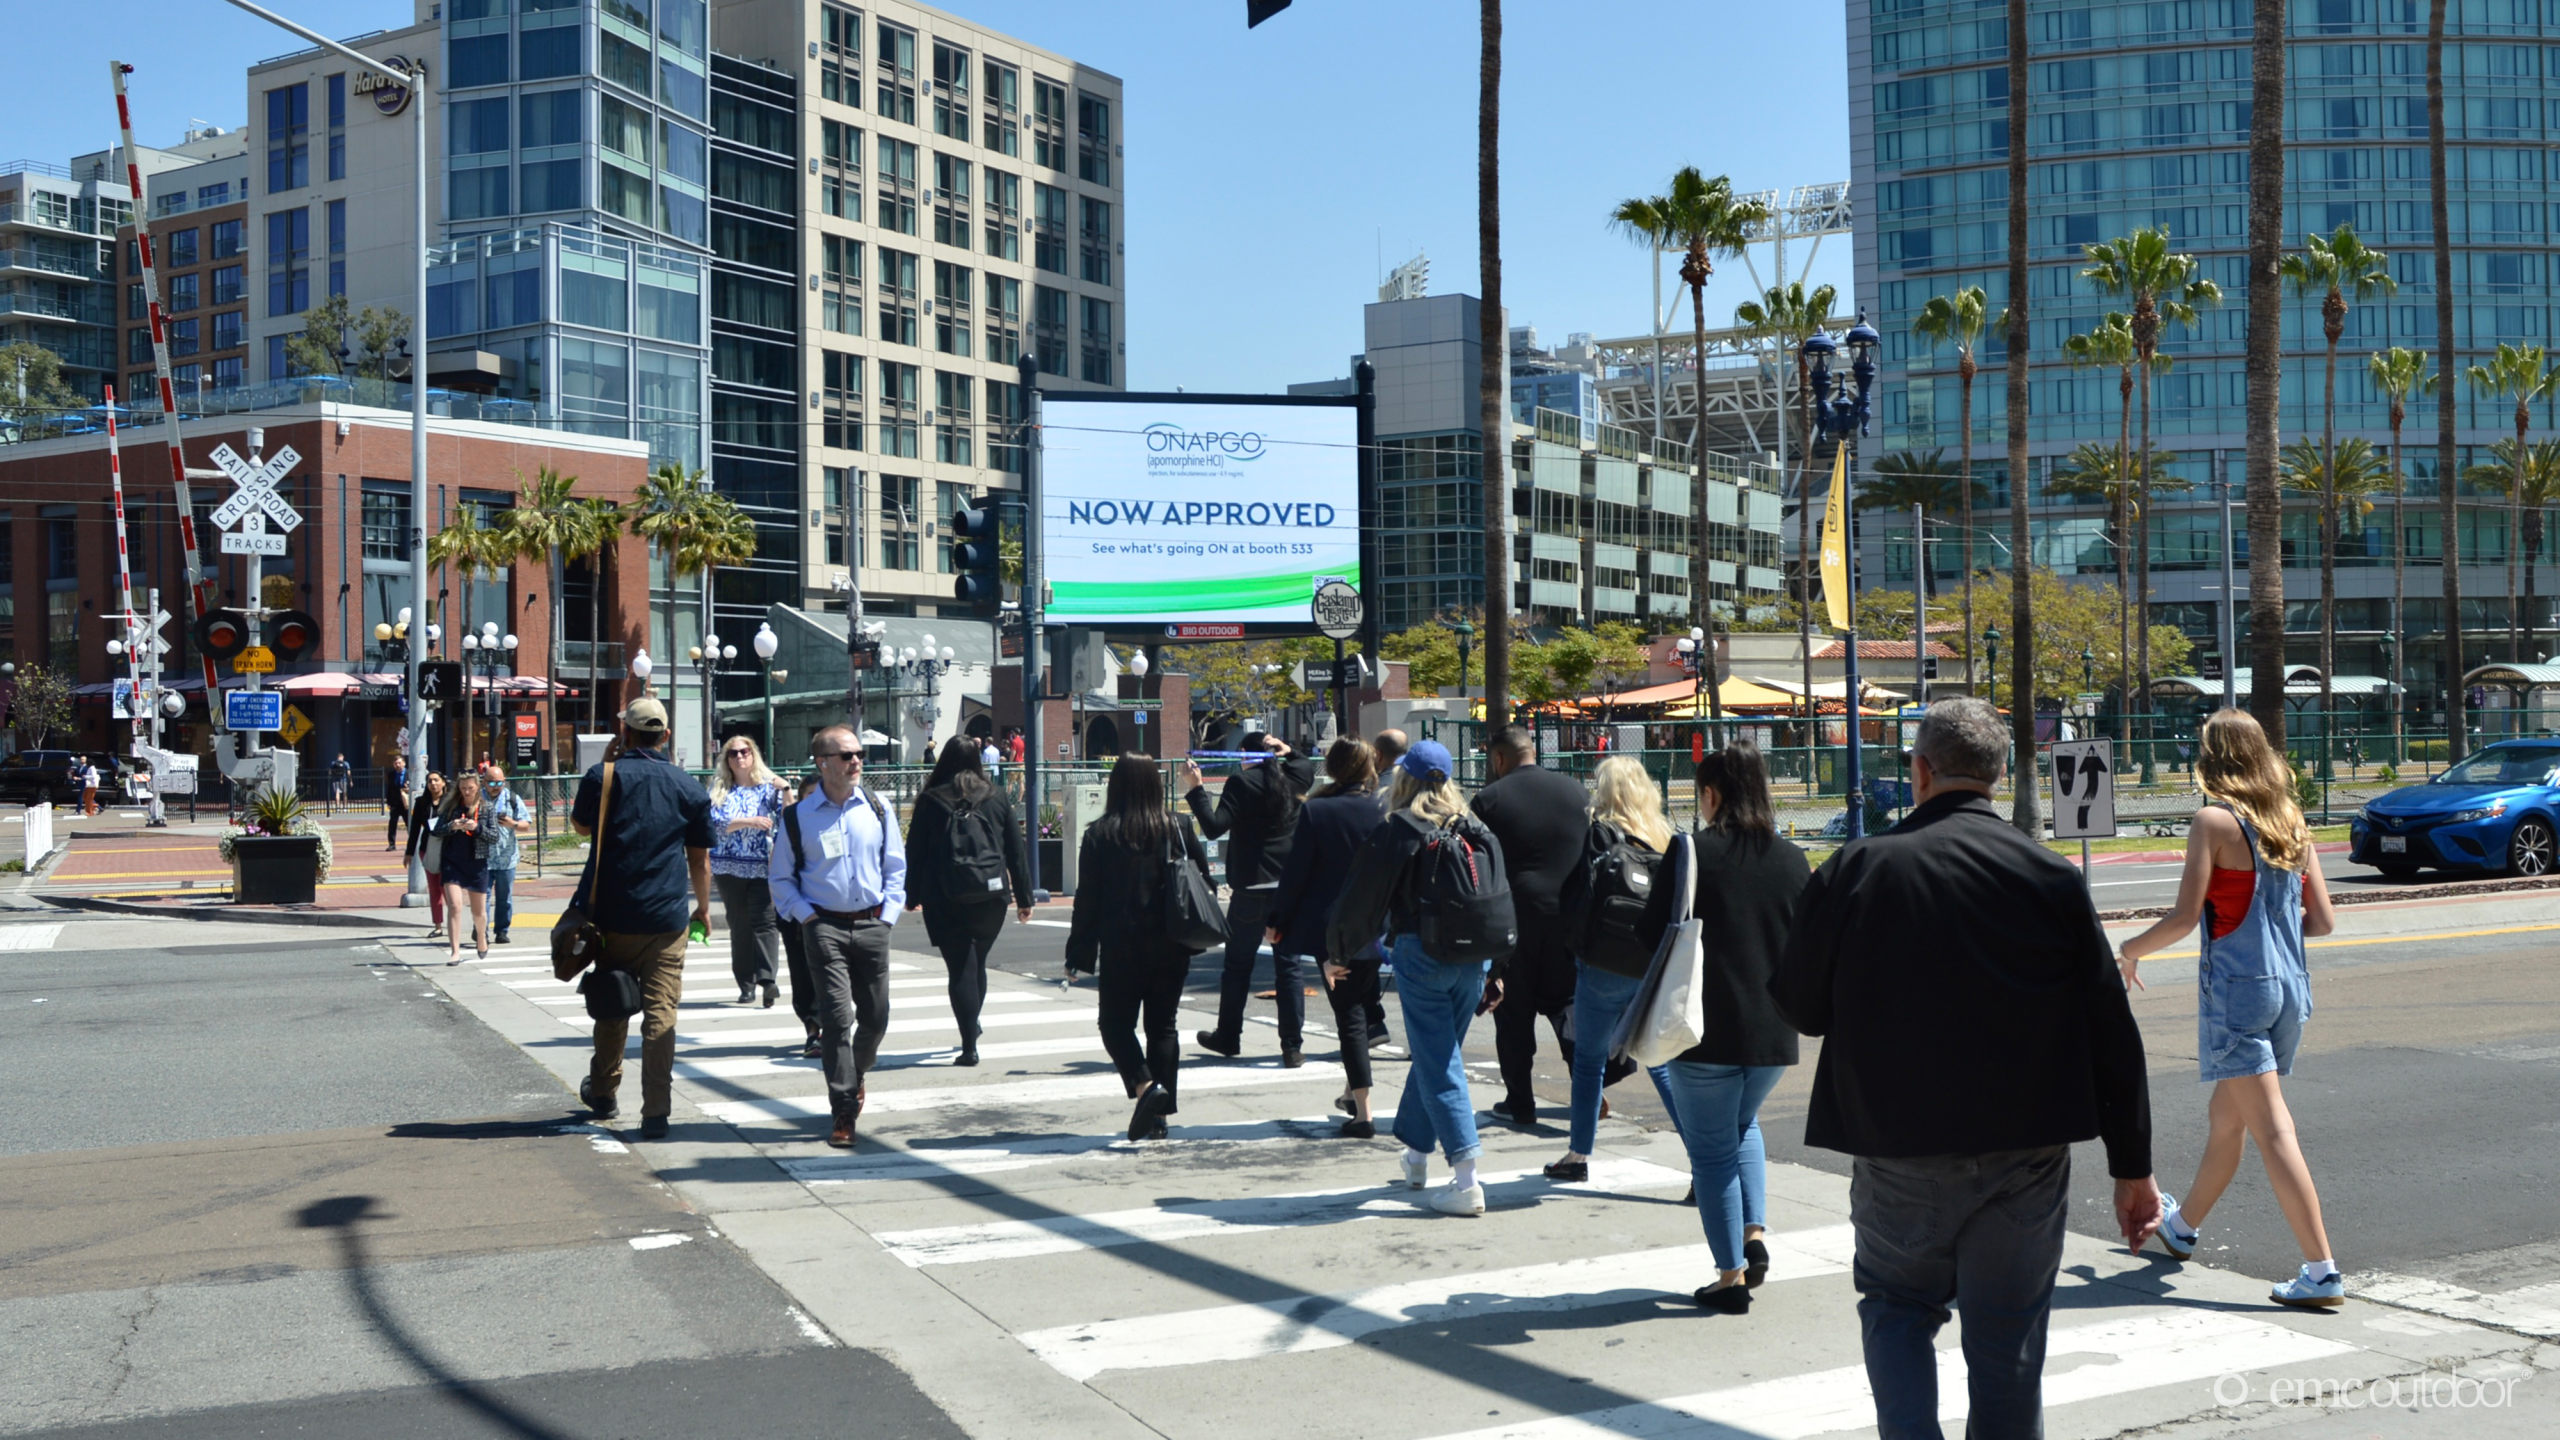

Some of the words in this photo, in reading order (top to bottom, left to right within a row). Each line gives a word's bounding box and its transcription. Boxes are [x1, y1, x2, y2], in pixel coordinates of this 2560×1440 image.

[377, 93, 399, 104] HOTEL
[1147, 454, 1205, 469] (apomorphine
[215, 448, 249, 485] RAIL
[260, 491, 296, 527] ROAD
[216, 450, 296, 526] CROSSING
[1070, 501, 1154, 525] NOW
[1162, 502, 1335, 527] APPROVED
[250, 517, 259, 531] 3
[225, 538, 282, 550] TRACKS
[1092, 543, 1115, 553] See
[1120, 542, 1163, 553] what's
[1167, 542, 1204, 556] going
[1208, 543, 1228, 553] ON
[1232, 544, 1245, 553] at
[1249, 542, 1287, 554] booth
[1291, 544, 1313, 554] 533
[1182, 626, 1197, 635] BIG
[1199, 626, 1239, 635] OUTDOOR
[247, 650, 260, 658] NO
[236, 661, 253, 669] TRAIN
[256, 661, 273, 669] HORN
[365, 687, 397, 696] NOBU
[231, 696, 248, 704] REPORT
